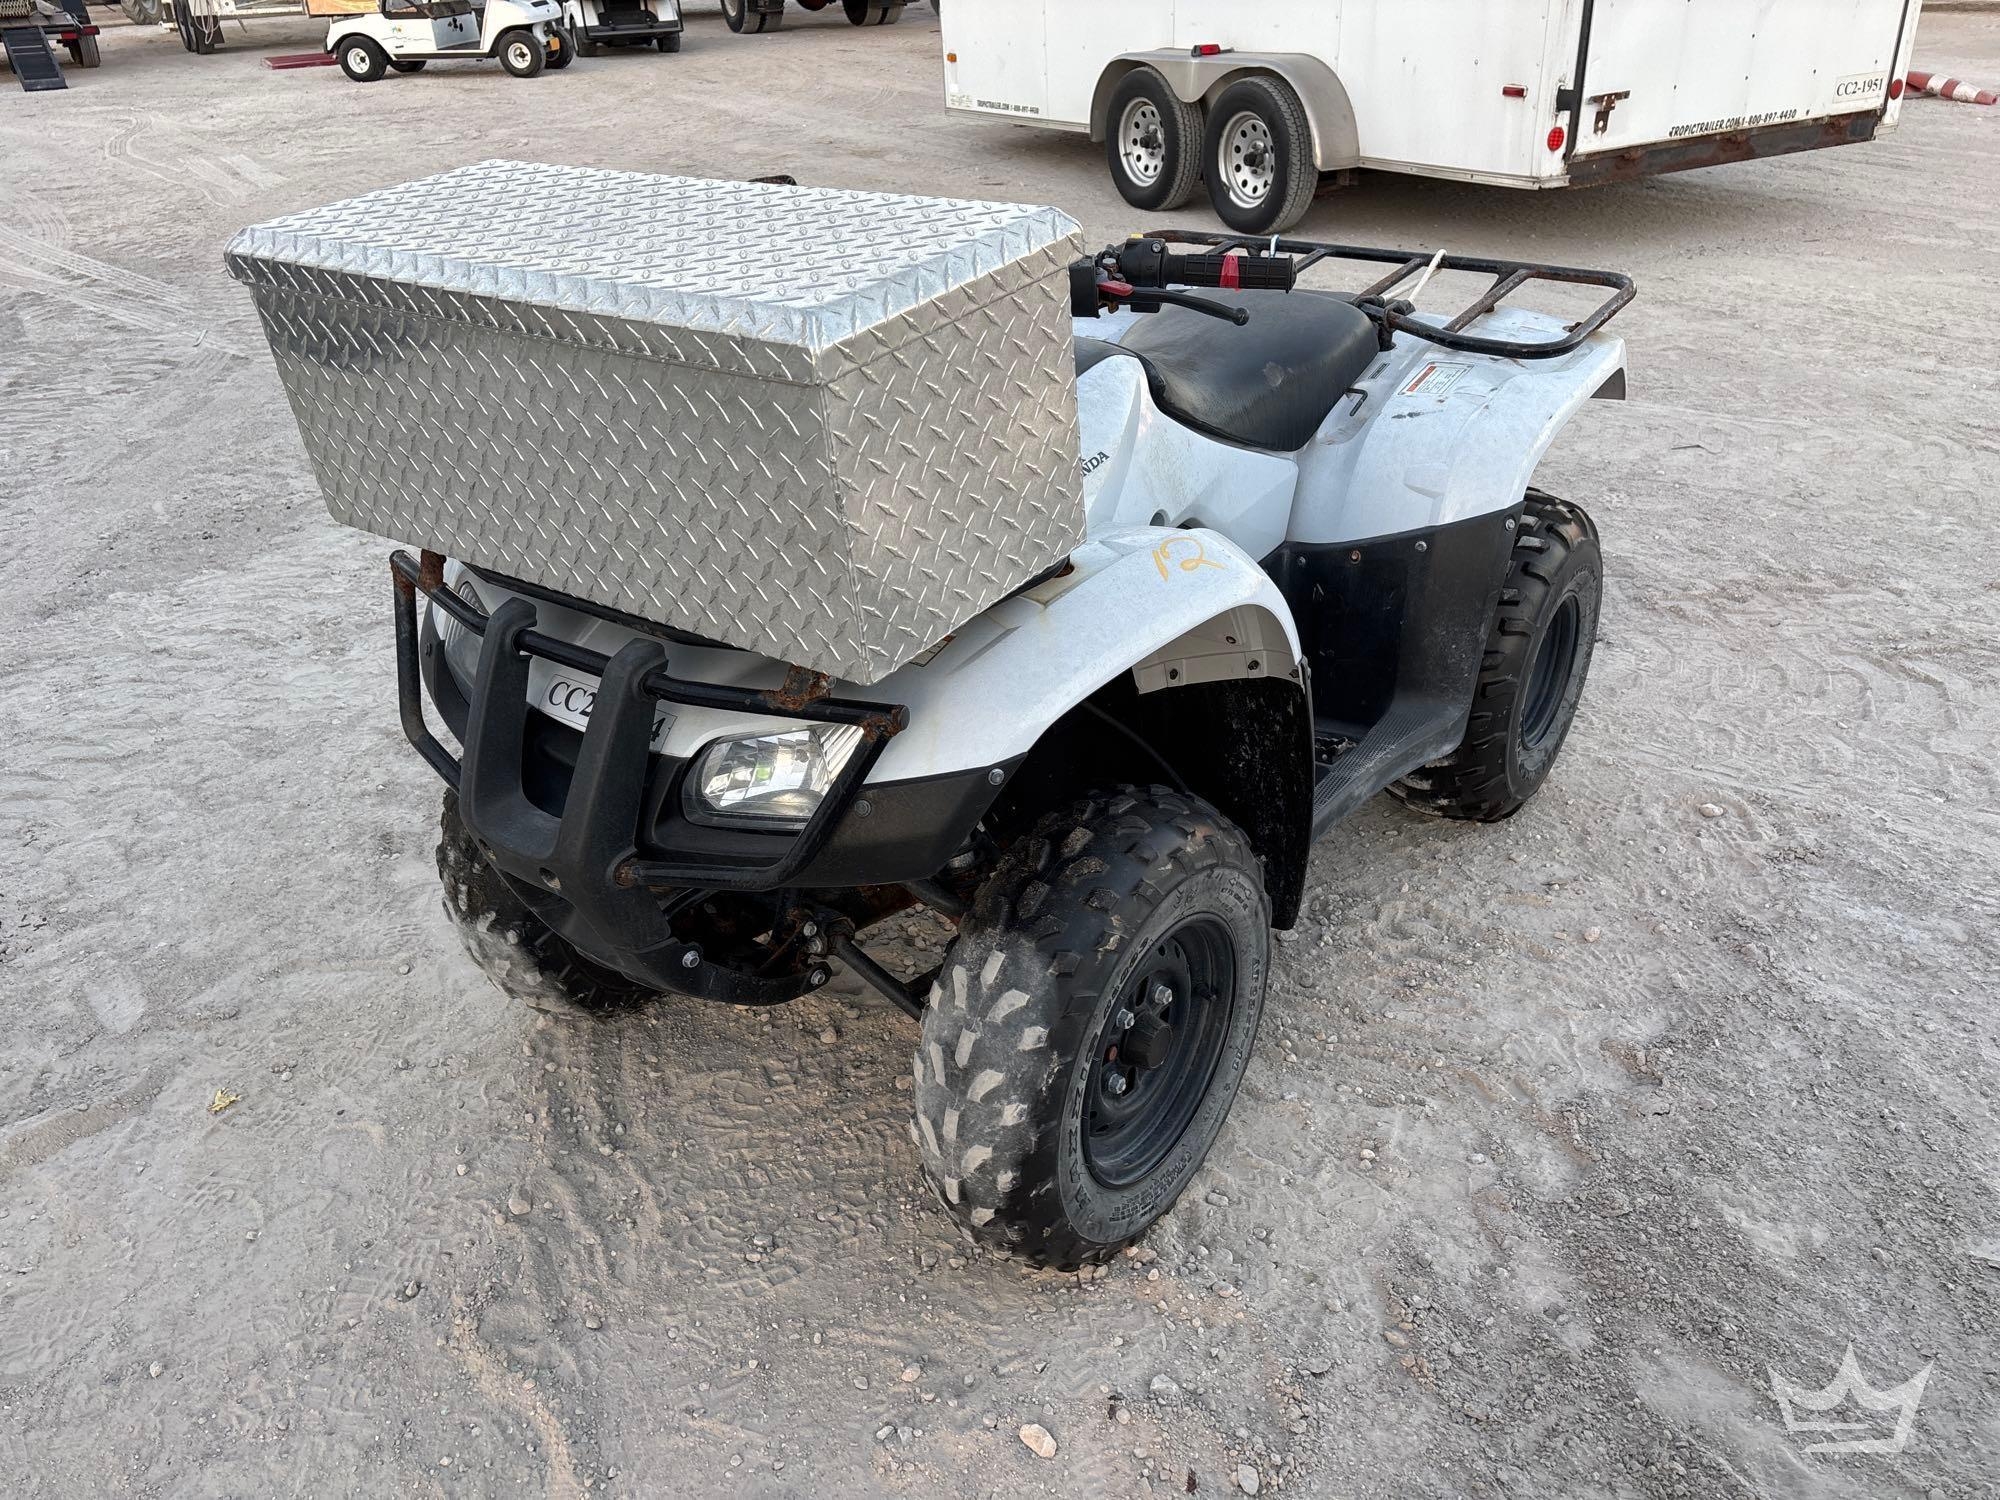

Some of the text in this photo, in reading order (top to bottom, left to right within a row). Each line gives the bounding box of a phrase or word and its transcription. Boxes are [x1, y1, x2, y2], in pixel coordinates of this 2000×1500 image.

[1836, 77, 1884, 97] CC2-1951
[1669, 108, 1797, 137] TROPICTRAILER.COM 1-800-897-4430
[1080, 451, 1110, 477] NDA
[1152, 536, 1228, 582] 12
